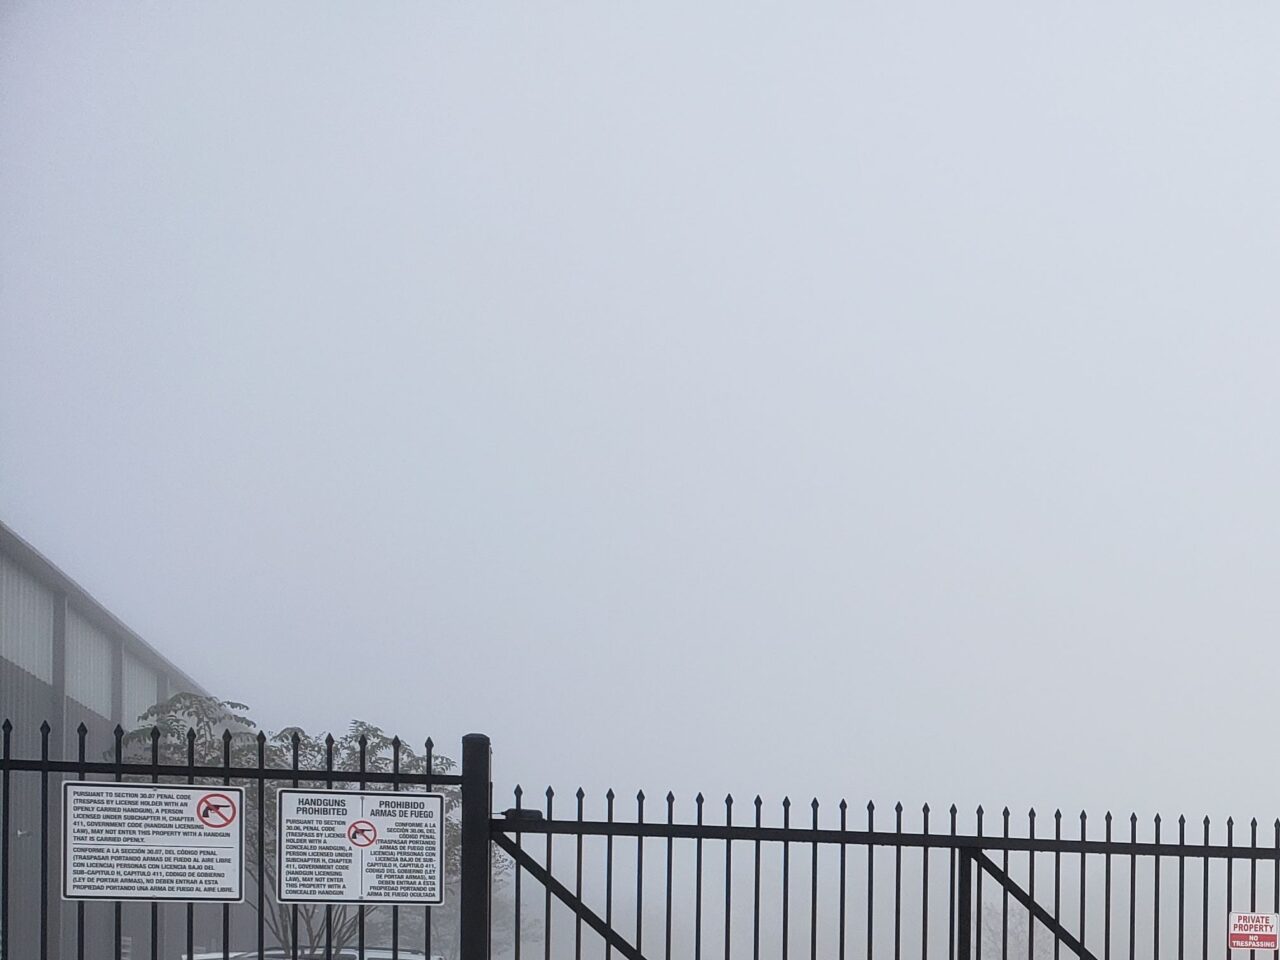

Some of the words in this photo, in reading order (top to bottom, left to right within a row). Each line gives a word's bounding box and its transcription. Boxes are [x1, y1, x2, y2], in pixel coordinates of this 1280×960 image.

[72, 798, 104, 806] (TRESPASS
[298, 798, 346, 807] HANDGUNS
[379, 801, 425, 809] PROHIBIDO
[296, 807, 347, 816] PROHIBITED
[370, 809, 396, 817] ARMAS
[398, 810, 408, 818] DE
[410, 810, 433, 818] FUEGO
